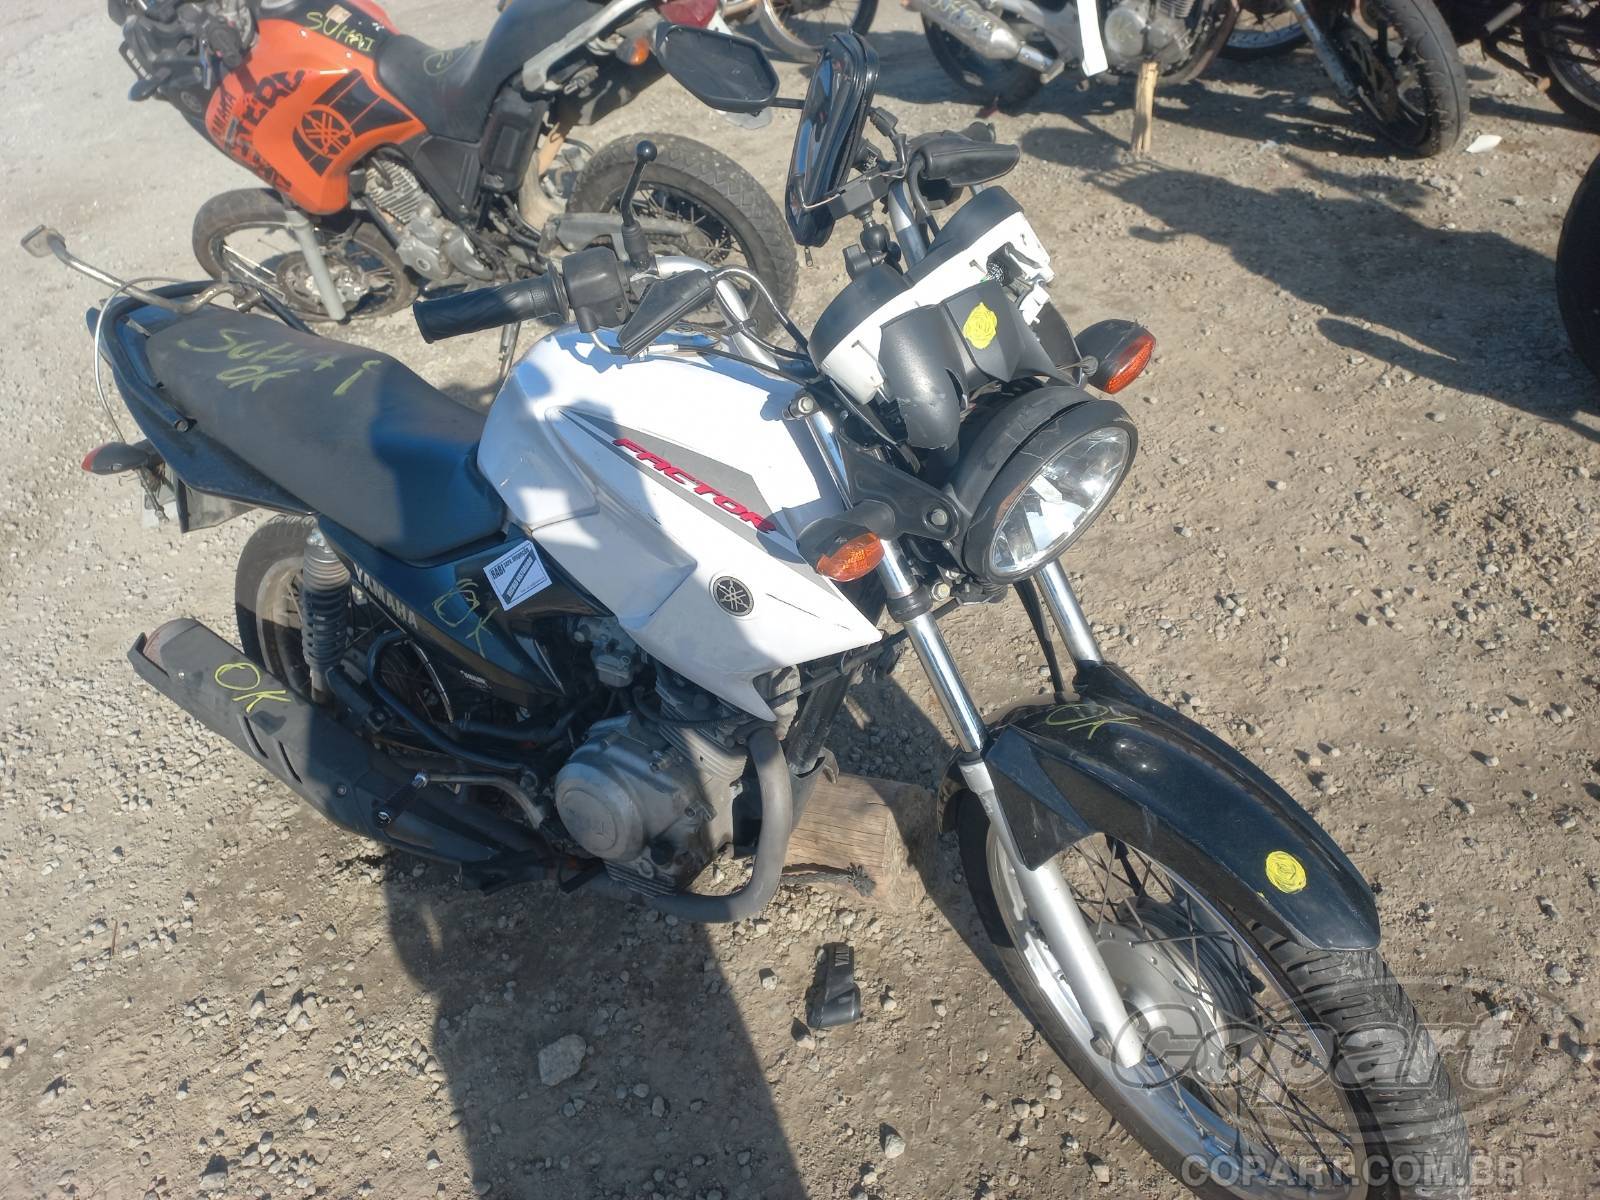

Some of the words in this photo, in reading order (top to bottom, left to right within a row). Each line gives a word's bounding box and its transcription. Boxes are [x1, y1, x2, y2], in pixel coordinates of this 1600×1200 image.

[612, 437, 778, 534] FACTOR
[353, 562, 418, 630] YAMAHA
[214, 662, 292, 713] OK
